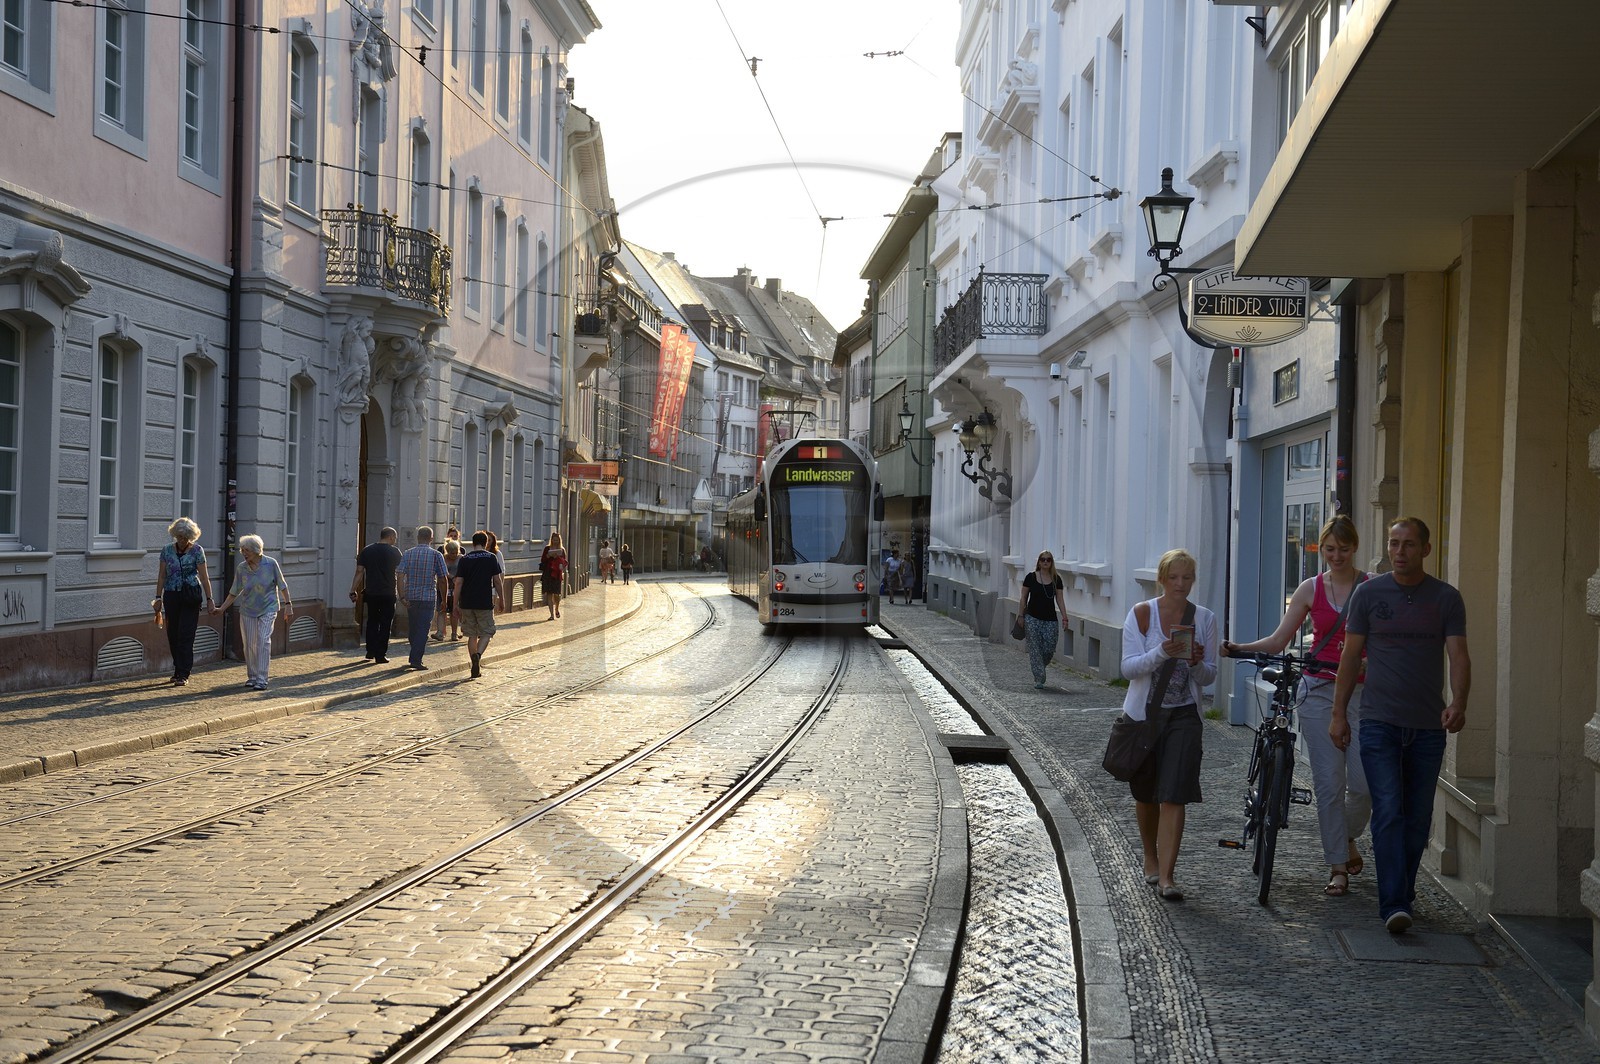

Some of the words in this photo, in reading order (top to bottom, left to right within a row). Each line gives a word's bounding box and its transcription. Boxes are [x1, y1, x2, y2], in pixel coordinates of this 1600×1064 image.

[1197, 295, 1262, 316] 2-LÄNDER
[1267, 298, 1303, 316] STUBE
[817, 447, 823, 458] 1
[785, 467, 855, 482] Landwasser
[780, 608, 795, 616] 284
